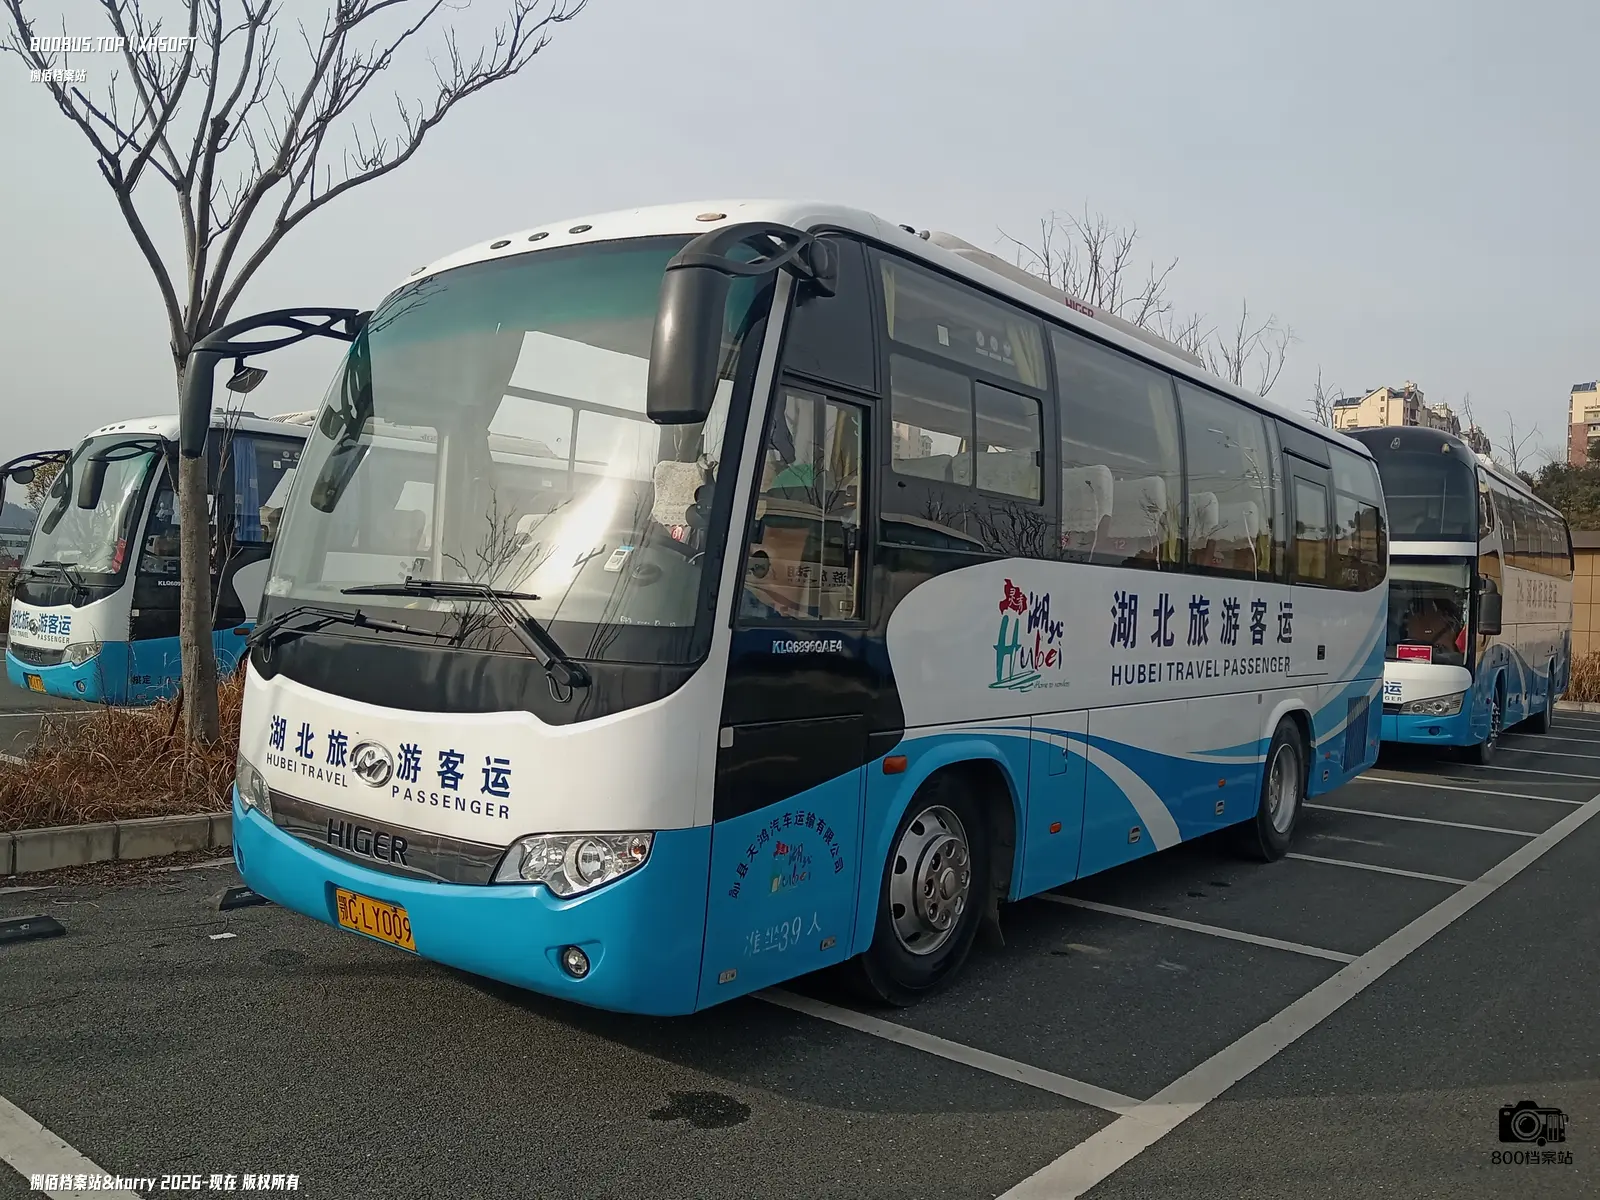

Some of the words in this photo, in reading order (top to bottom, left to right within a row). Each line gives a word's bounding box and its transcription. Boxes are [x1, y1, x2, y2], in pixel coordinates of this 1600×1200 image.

[37, 633, 70, 644] PASSENGER
[1109, 590, 1294, 649] 湖北旅游客运
[992, 614, 1063, 683] Hubei
[1111, 661, 1163, 686] HUBEI
[1167, 658, 1220, 682] TRAVEL
[1223, 656, 1291, 677] PASSENGER
[266, 752, 297, 773] HUBEI
[302, 762, 348, 788] TRAVEL
[391, 785, 510, 820] PASSENGER
[326, 818, 408, 867] HIGER
